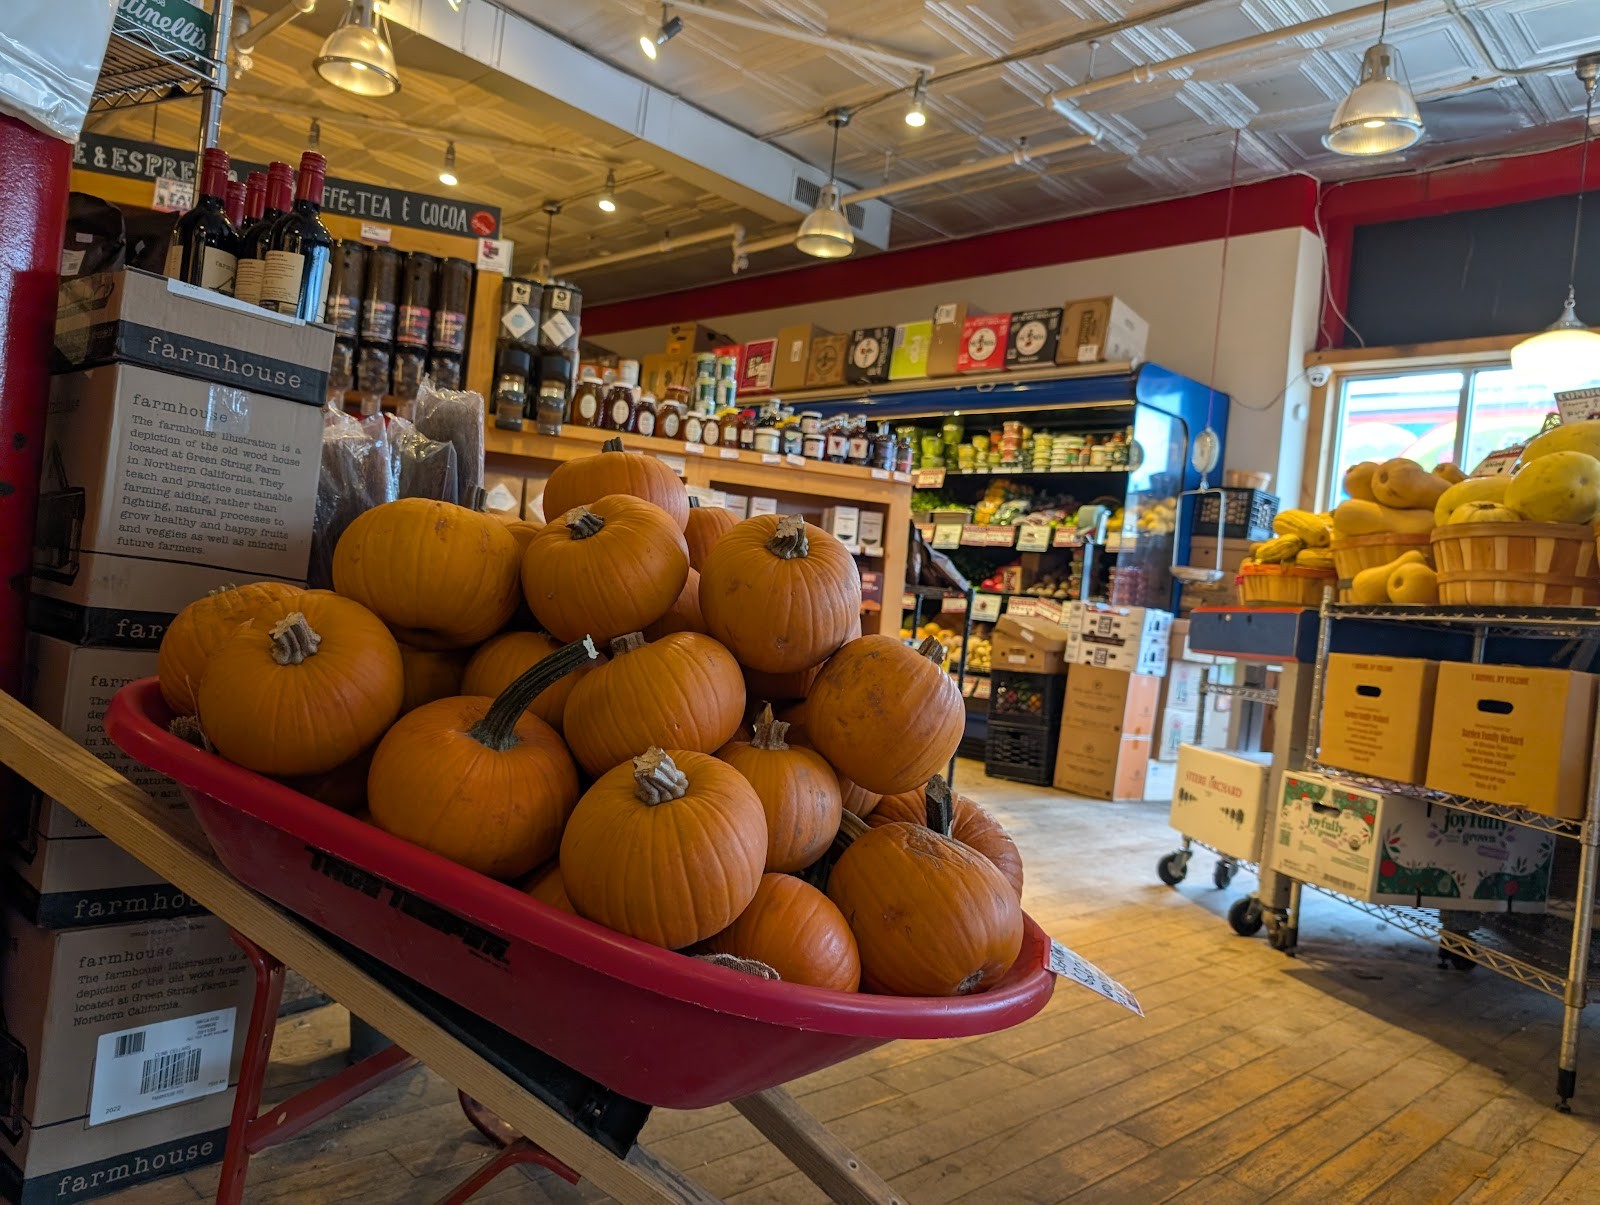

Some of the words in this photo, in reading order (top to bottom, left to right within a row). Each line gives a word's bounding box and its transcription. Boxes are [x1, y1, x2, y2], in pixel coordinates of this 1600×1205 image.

[93, 146, 107, 168] &
[355, 190, 392, 219] TEA
[420, 200, 468, 233] COCOA
[146, 334, 302, 389] farmhouse
[132, 393, 228, 422] farmhouse
[130, 429, 180, 445] depiction
[201, 442, 218, 452] the
[222, 446, 238, 455] old
[243, 450, 267, 461] wood
[272, 455, 301, 466] house
[131, 414, 153, 426] The
[159, 420, 217, 438] farmhouse
[221, 432, 277, 450] illustration
[282, 444, 290, 452] is
[127, 455, 139, 464] in
[144, 458, 196, 474] Northern
[200, 467, 255, 484] California.
[259, 477, 285, 490] They
[128, 442, 168, 456] located
[186, 452, 217, 464] Green
[220, 458, 252, 472] String
[255, 464, 281, 475] Farm
[123, 483, 171, 498] farming
[174, 490, 211, 504] aiding,
[215, 497, 250, 508] rather
[253, 502, 277, 513] than
[126, 469, 157, 481] teach
[161, 476, 183, 486] and
[187, 480, 231, 493] practice
[234, 487, 293, 502] sustainable
[120, 510, 150, 520] grow
[154, 514, 197, 528] healthy
[200, 522, 221, 531] and
[224, 523, 257, 536] happy
[260, 528, 289, 540] fruits
[122, 495, 171, 512] fighting,
[175, 504, 216, 516] natural
[220, 510, 271, 524] processes
[274, 517, 284, 526] to
[116, 536, 154, 548] future
[158, 541, 205, 554] farmers.
[118, 524, 141, 533] and
[145, 527, 187, 539] veggies
[207, 535, 229, 544] well
[247, 540, 287, 552] mindful
[115, 619, 164, 639] far
[1307, 813, 1344, 834] joyfully
[1462, 833, 1496, 846] grown
[74, 892, 201, 919] farmho
[77, 975, 99, 985] The
[104, 966, 164, 981] farmhouse
[168, 955, 223, 971] illustration
[78, 946, 175, 968] farmhouse
[75, 998, 114, 1013] located
[117, 996, 129, 1005] at
[132, 991, 163, 1003] Green
[166, 985, 199, 998] String
[200, 980, 227, 992] Farm
[77, 984, 127, 1002] depiction
[131, 980, 144, 990] of
[147, 976, 164, 987] the
[168, 974, 184, 983] old
[189, 970, 214, 981] wood
[218, 966, 247, 977] house
[73, 1011, 124, 1027] Northern
[105, 1105, 121, 1114] 2022
[57, 1140, 215, 1197] farmhouse
